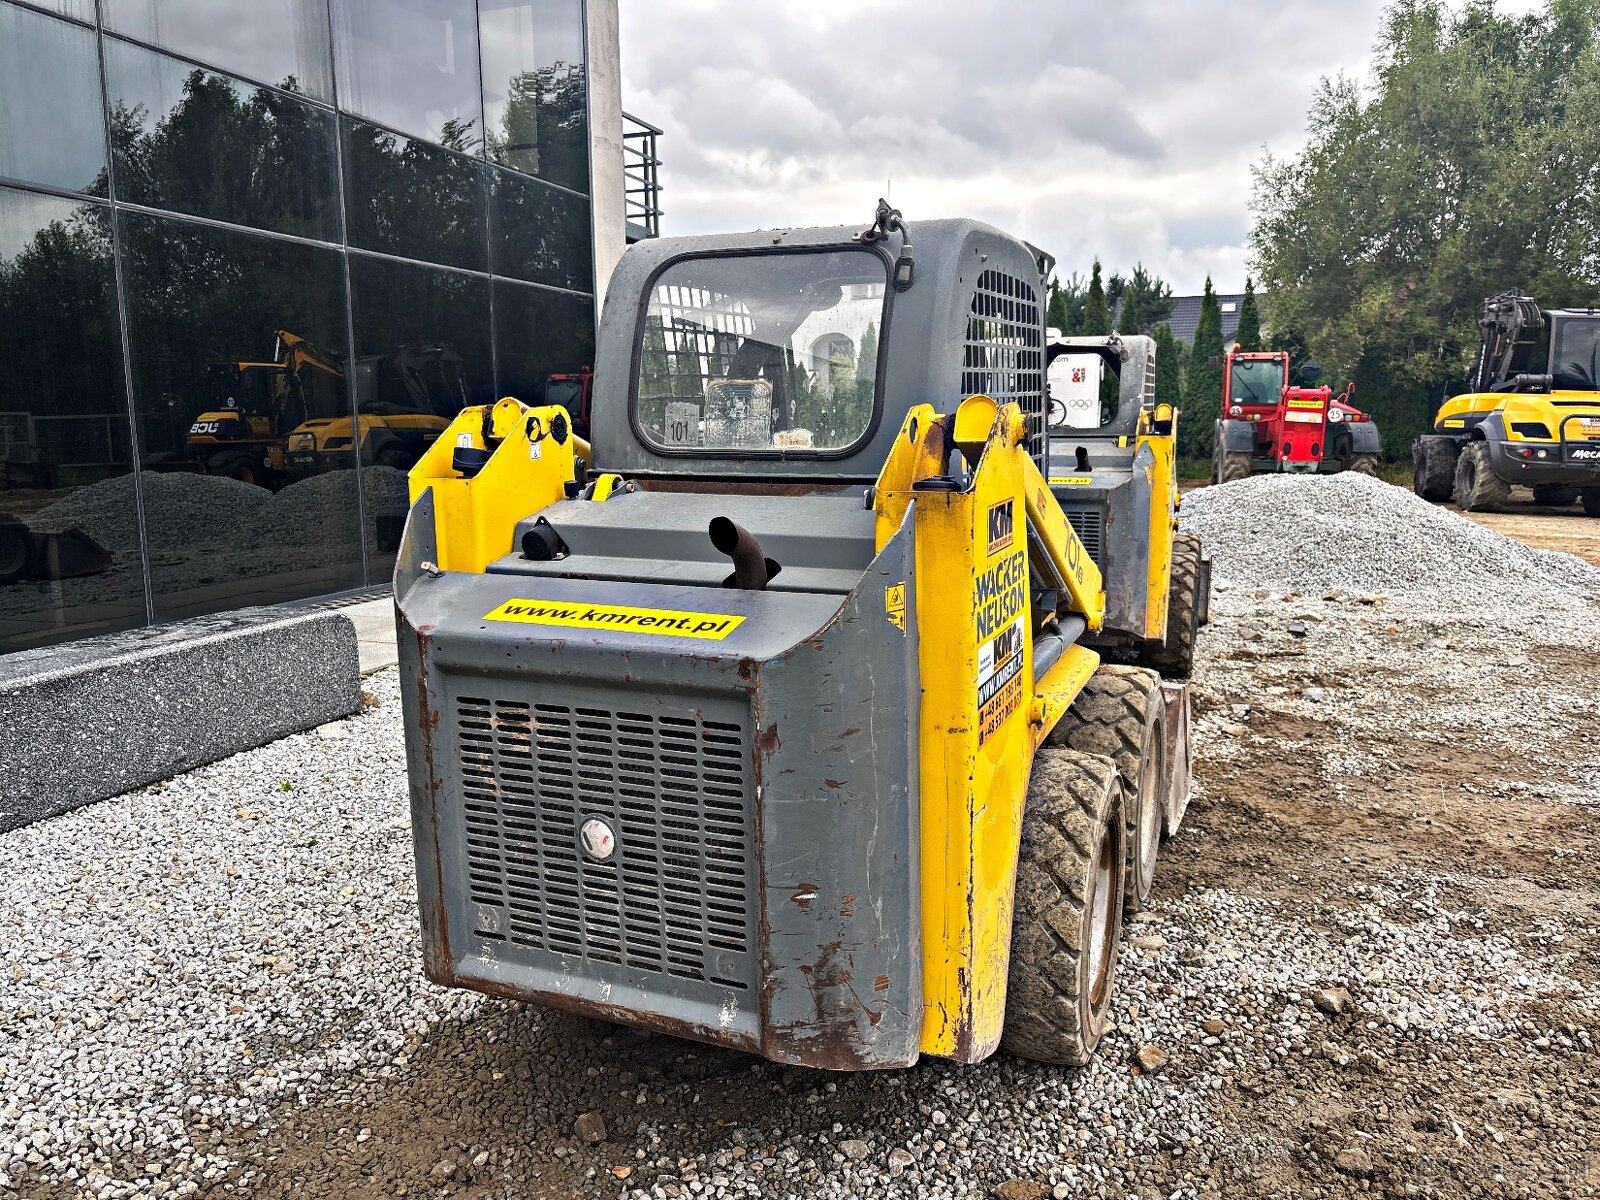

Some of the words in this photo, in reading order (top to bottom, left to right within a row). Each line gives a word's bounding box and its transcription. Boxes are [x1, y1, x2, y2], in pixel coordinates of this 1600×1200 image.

[671, 421, 689, 441] 101
[1330, 410, 1341, 419] 25
[988, 500, 1013, 543] KM
[976, 550, 1025, 607] WACKER
[503, 604, 731, 634] www.kmrent.pl
[976, 579, 1025, 644] NEUSON
